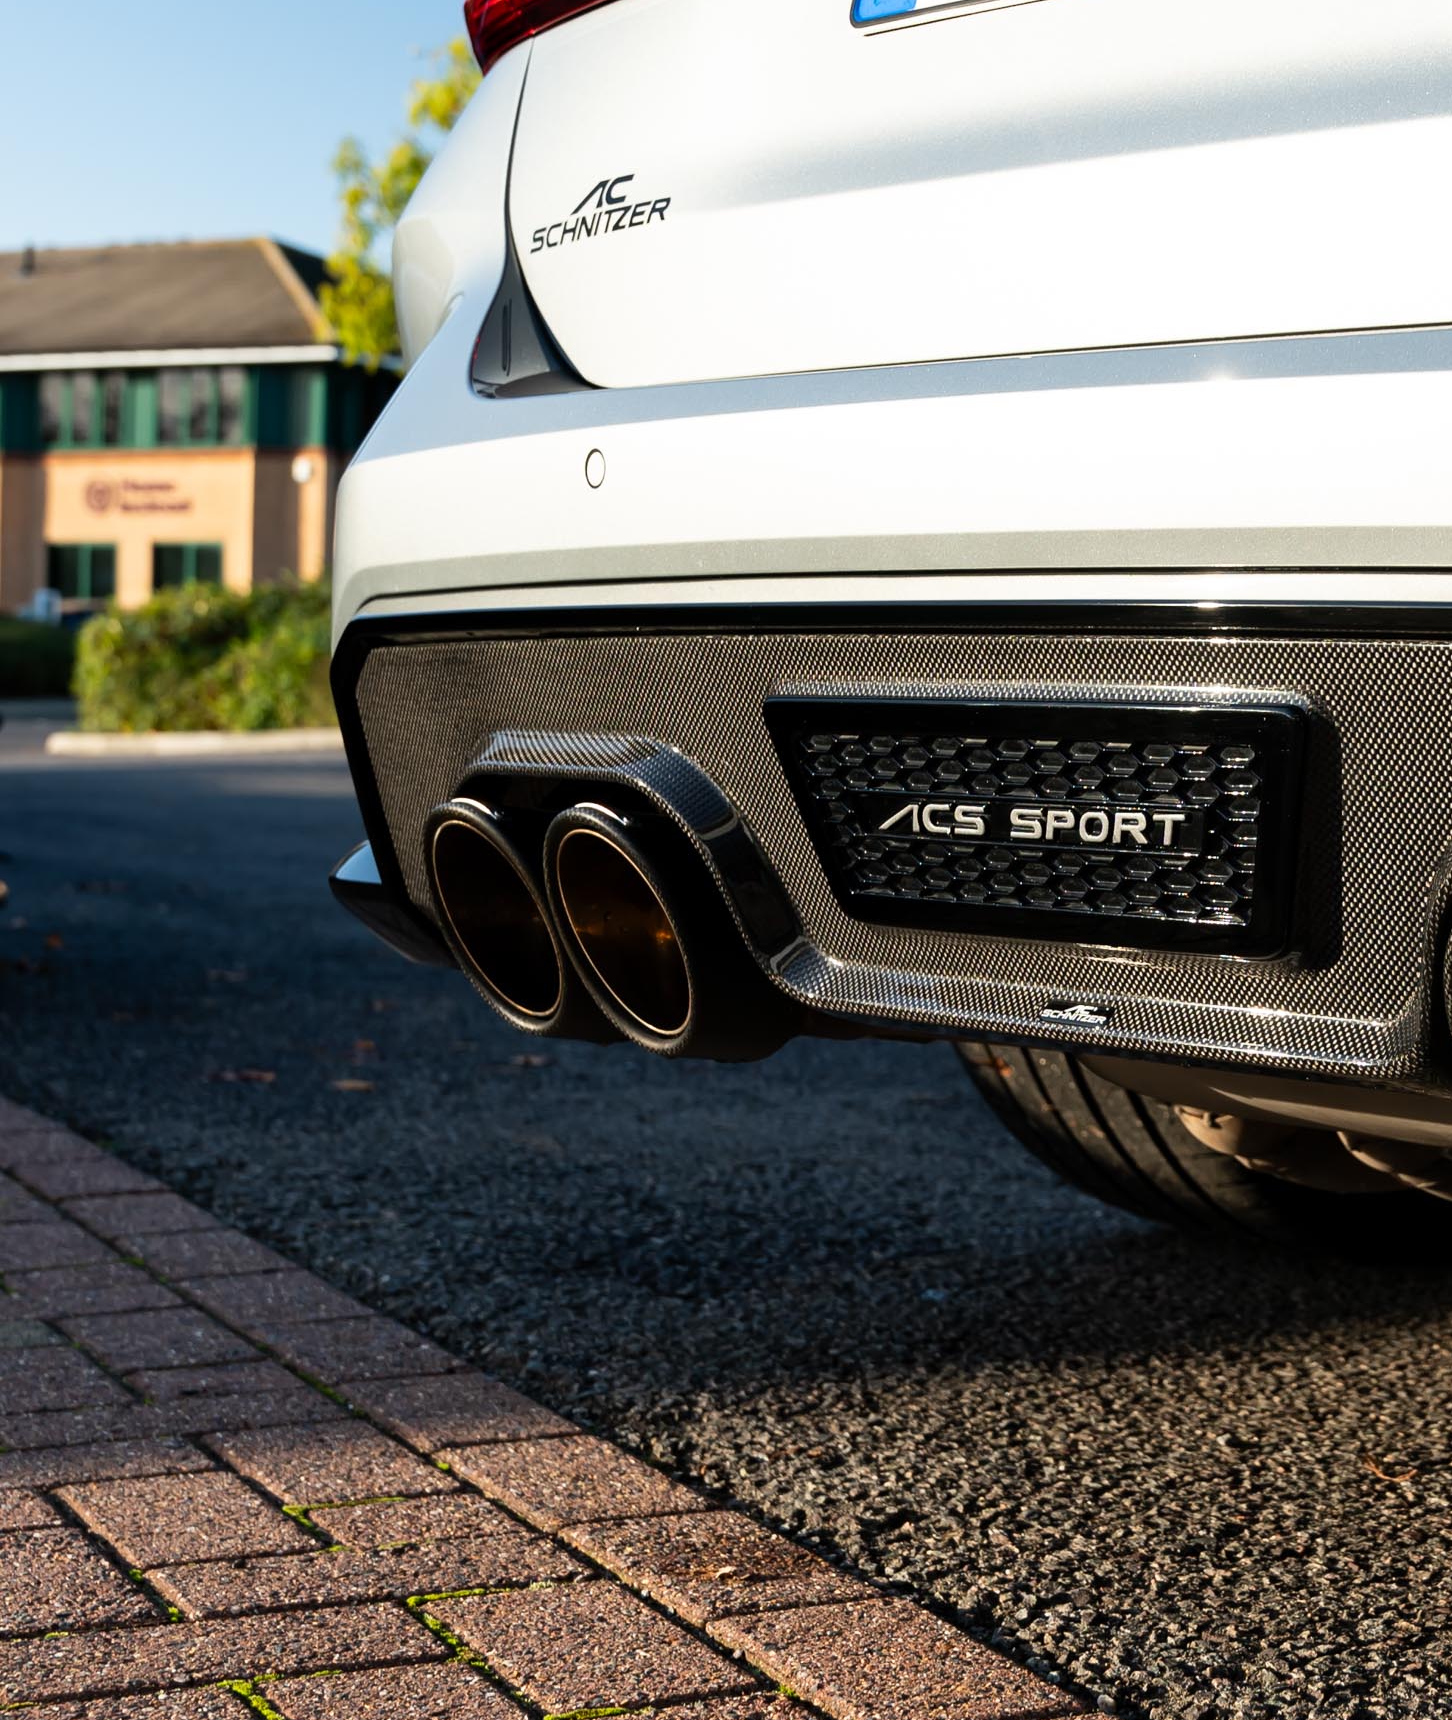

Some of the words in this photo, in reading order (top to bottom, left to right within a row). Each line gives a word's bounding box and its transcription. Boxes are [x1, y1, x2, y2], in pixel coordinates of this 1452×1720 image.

[570, 173, 635, 216] AC
[530, 197, 672, 254] SCHNITZER
[878, 802, 986, 837] ACS
[1009, 807, 1187, 847] SPORT
[1041, 1008, 1106, 1024] SCHNITZER
